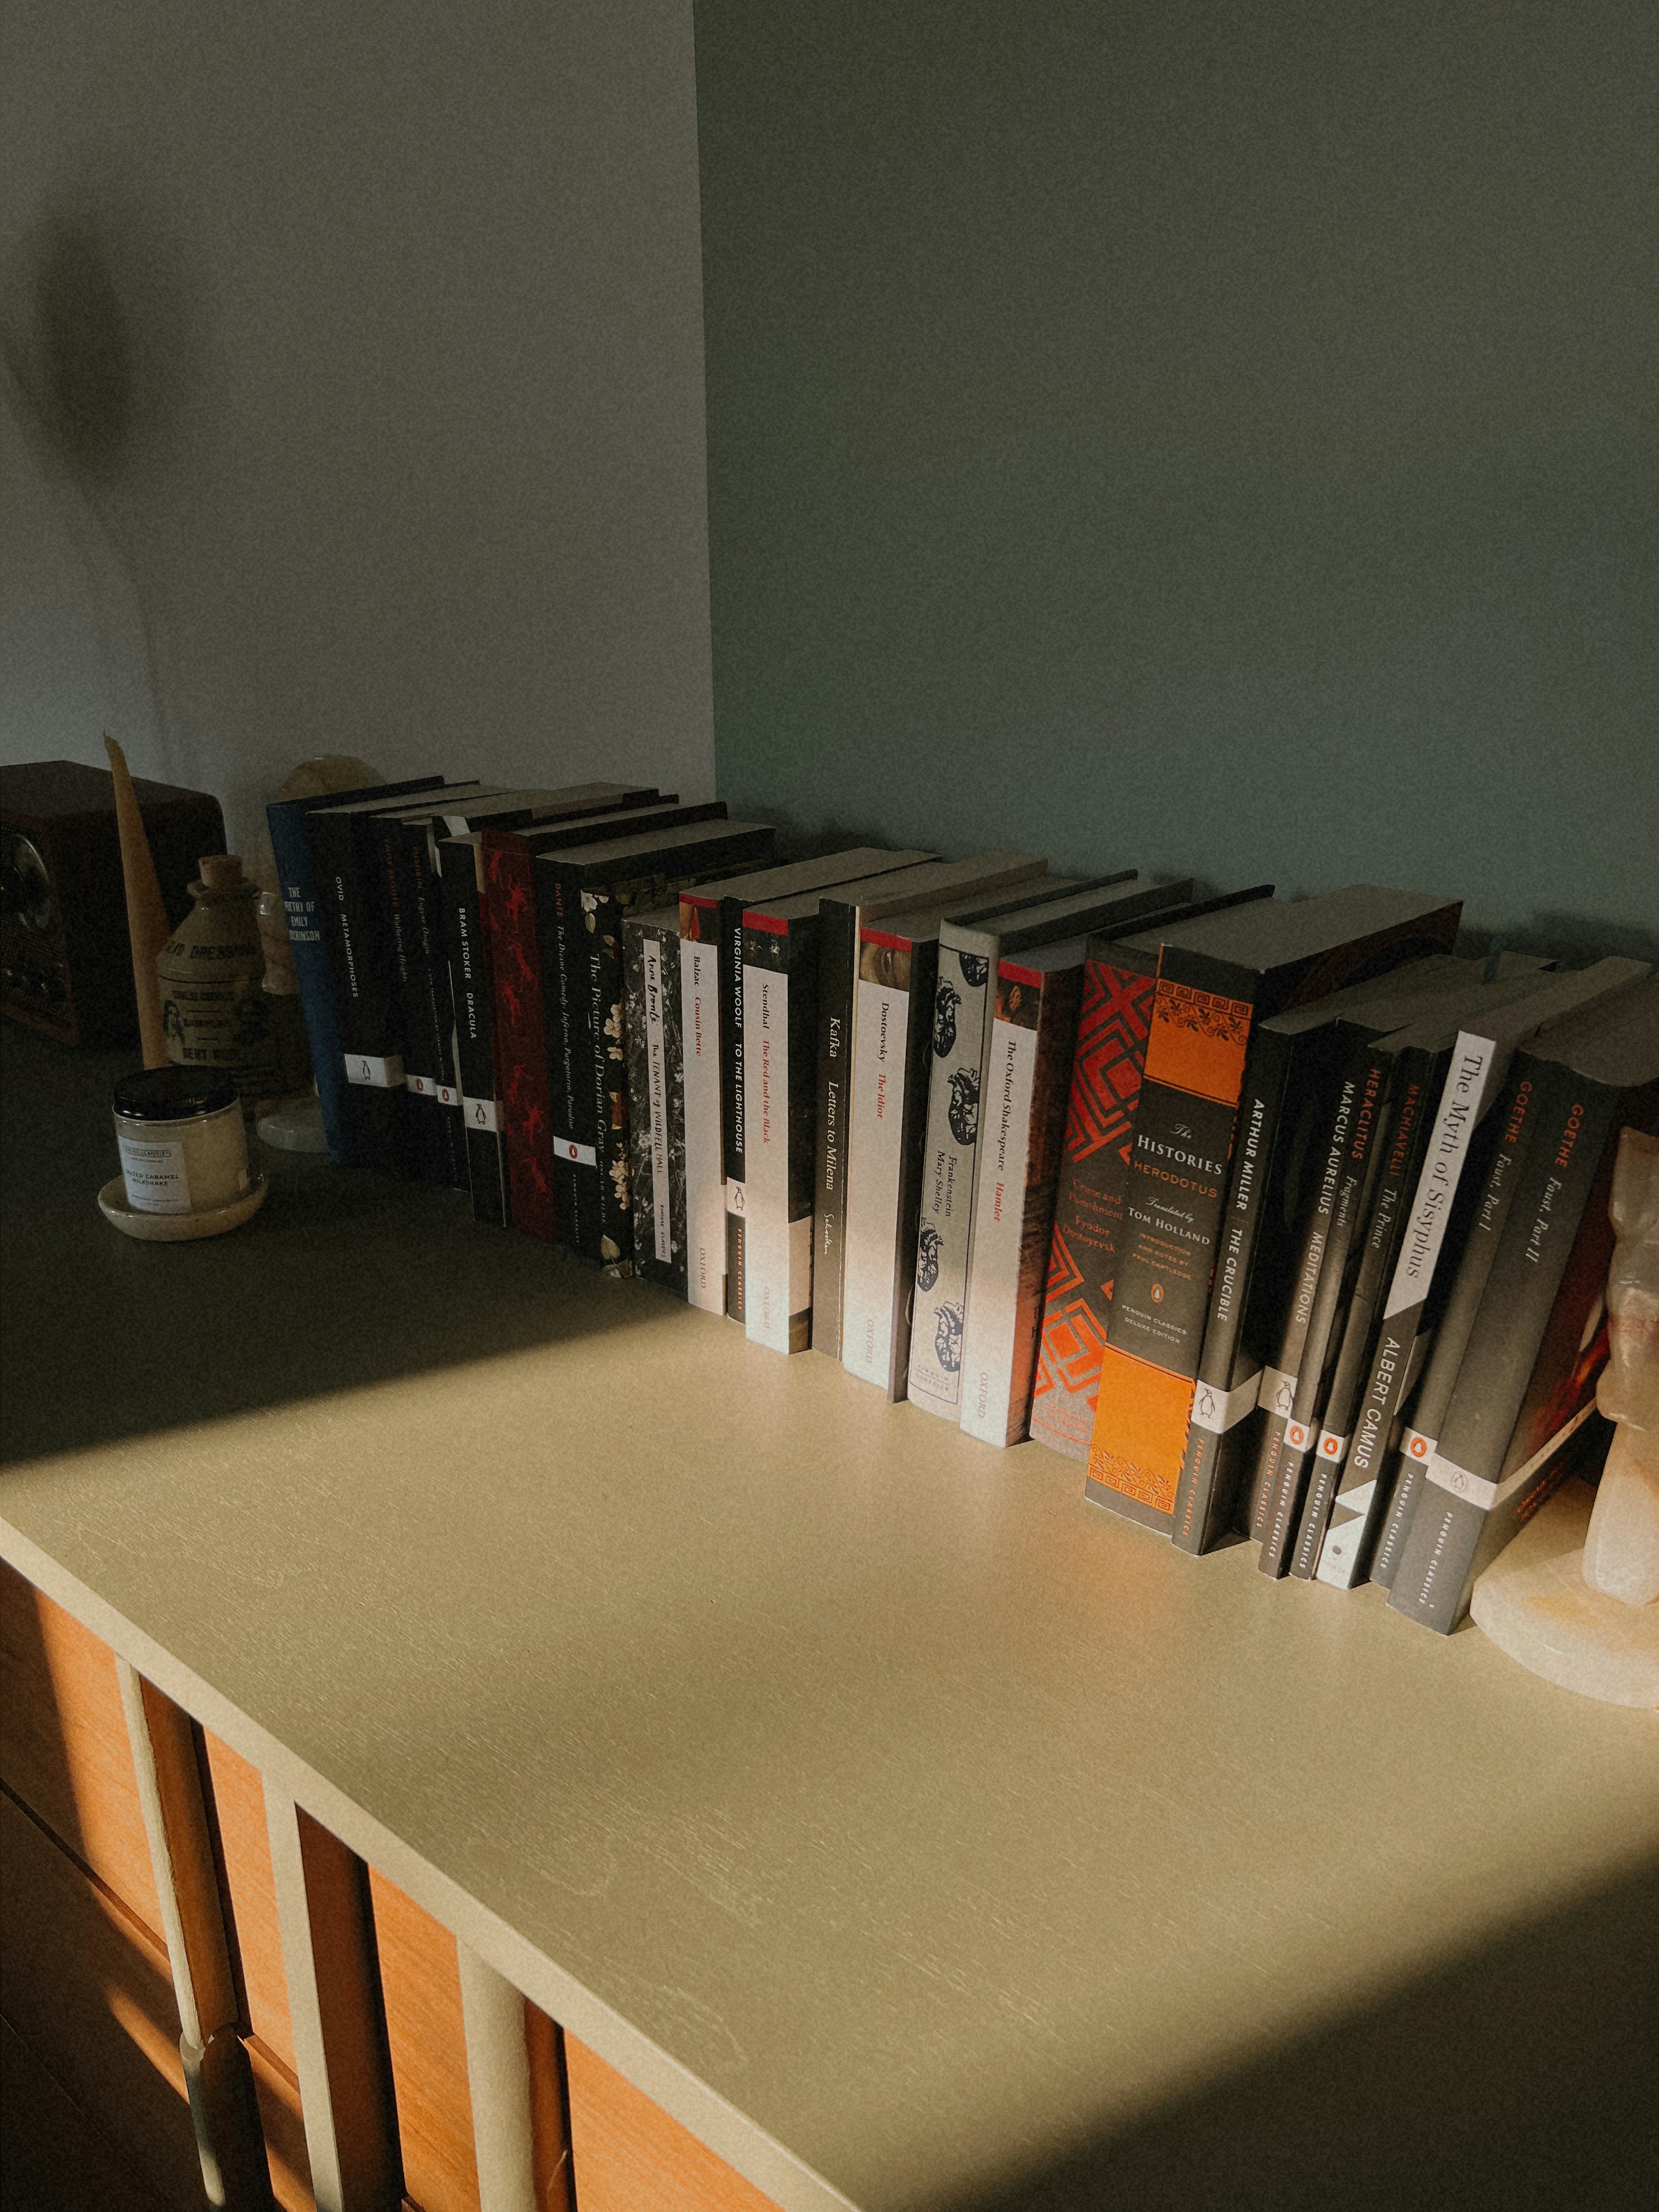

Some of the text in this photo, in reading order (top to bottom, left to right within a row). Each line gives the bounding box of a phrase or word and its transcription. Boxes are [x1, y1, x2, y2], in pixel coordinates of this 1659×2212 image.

[288, 887, 301, 898] THE
[306, 901, 315, 912] OF
[555, 883, 563, 917] DANTE
[291, 916, 308, 927] EMILY
[335, 876, 358, 998] OVID METAMORPHOSES
[394, 913, 404, 952] Wuthering
[399, 955, 408, 982] Heights
[558, 943, 566, 971] Divine
[647, 956, 657, 981] Anne
[459, 907, 477, 1039] BRAM STOKER DRACULA
[590, 953, 607, 1153] The Picture of Dorian Gray
[735, 1043, 742, 1058] TO
[877, 1002, 889, 1119] Dostoevsky The Idiot
[567, 1095, 575, 1130] Paradiso
[826, 1017, 840, 1191] Kafka Letters to Milena
[994, 1041, 1016, 1222] The Oxford Shakespeare Hamlet
[1137, 1134, 1222, 1175] HISTORIES
[1170, 1123, 1193, 1139] The
[1336, 1068, 1381, 1228] HERACLITUS Fragments
[1134, 1161, 1217, 1198] HERODOTUS
[1372, 1083, 1420, 1249] MACHIAVELLI The Prince
[1406, 1055, 1483, 1278] The Myth of Sisyphus
[1479, 1080, 1533, 1232] GOETHE Faust, Part I
[133, 1178, 169, 1187] MILKSHAKE
[933, 1150, 945, 1215] Mary Shelley
[945, 1155, 957, 1217] Frankenstein
[1073, 1180, 1121, 1205] Crime and
[1295, 1081, 1356, 1324] MARCUS AURELIUS MEDITATIONS
[1525, 1103, 1584, 1262] GOETHE Faust, Part II
[1069, 1192, 1124, 1221] Punishment
[1074, 1215, 1110, 1236] Fyodor
[1128, 1206, 1211, 1245] TOM HOLLAND
[1146, 1197, 1194, 1223] Translated by
[1217, 1098, 1265, 1322] ARTHUR MILLER THE CRUCIBLE
[1132, 1253, 1149, 1264] PAUL
[1138, 1244, 1152, 1254] AND
[1154, 1250, 1177, 1263] NOTES
[1139, 1233, 1191, 1256] INTRODUCTION
[866, 1319, 874, 1364] OXFORD
[1122, 1304, 1187, 1335] PENGUIN CLASSICS
[1125, 1317, 1180, 1344] DELUXE EDITION
[978, 1372, 988, 1419] OXFORD
[1354, 1336, 1401, 1469] ALBERT CAMUS
[1182, 1438, 1205, 1537] PENGUIN CLASSICS
[1256, 1431, 1281, 1528] PENGUIN CLASSICS
[1268, 1461, 1294, 1558] PENGUIN CLASSICS
[1299, 1474, 1328, 1569] PENGUIN CLASSICS
[1380, 1473, 1413, 1569] PENGUIN CLASSICS
[1419, 1512, 1453, 1605] PENGUIN CLASSICS
